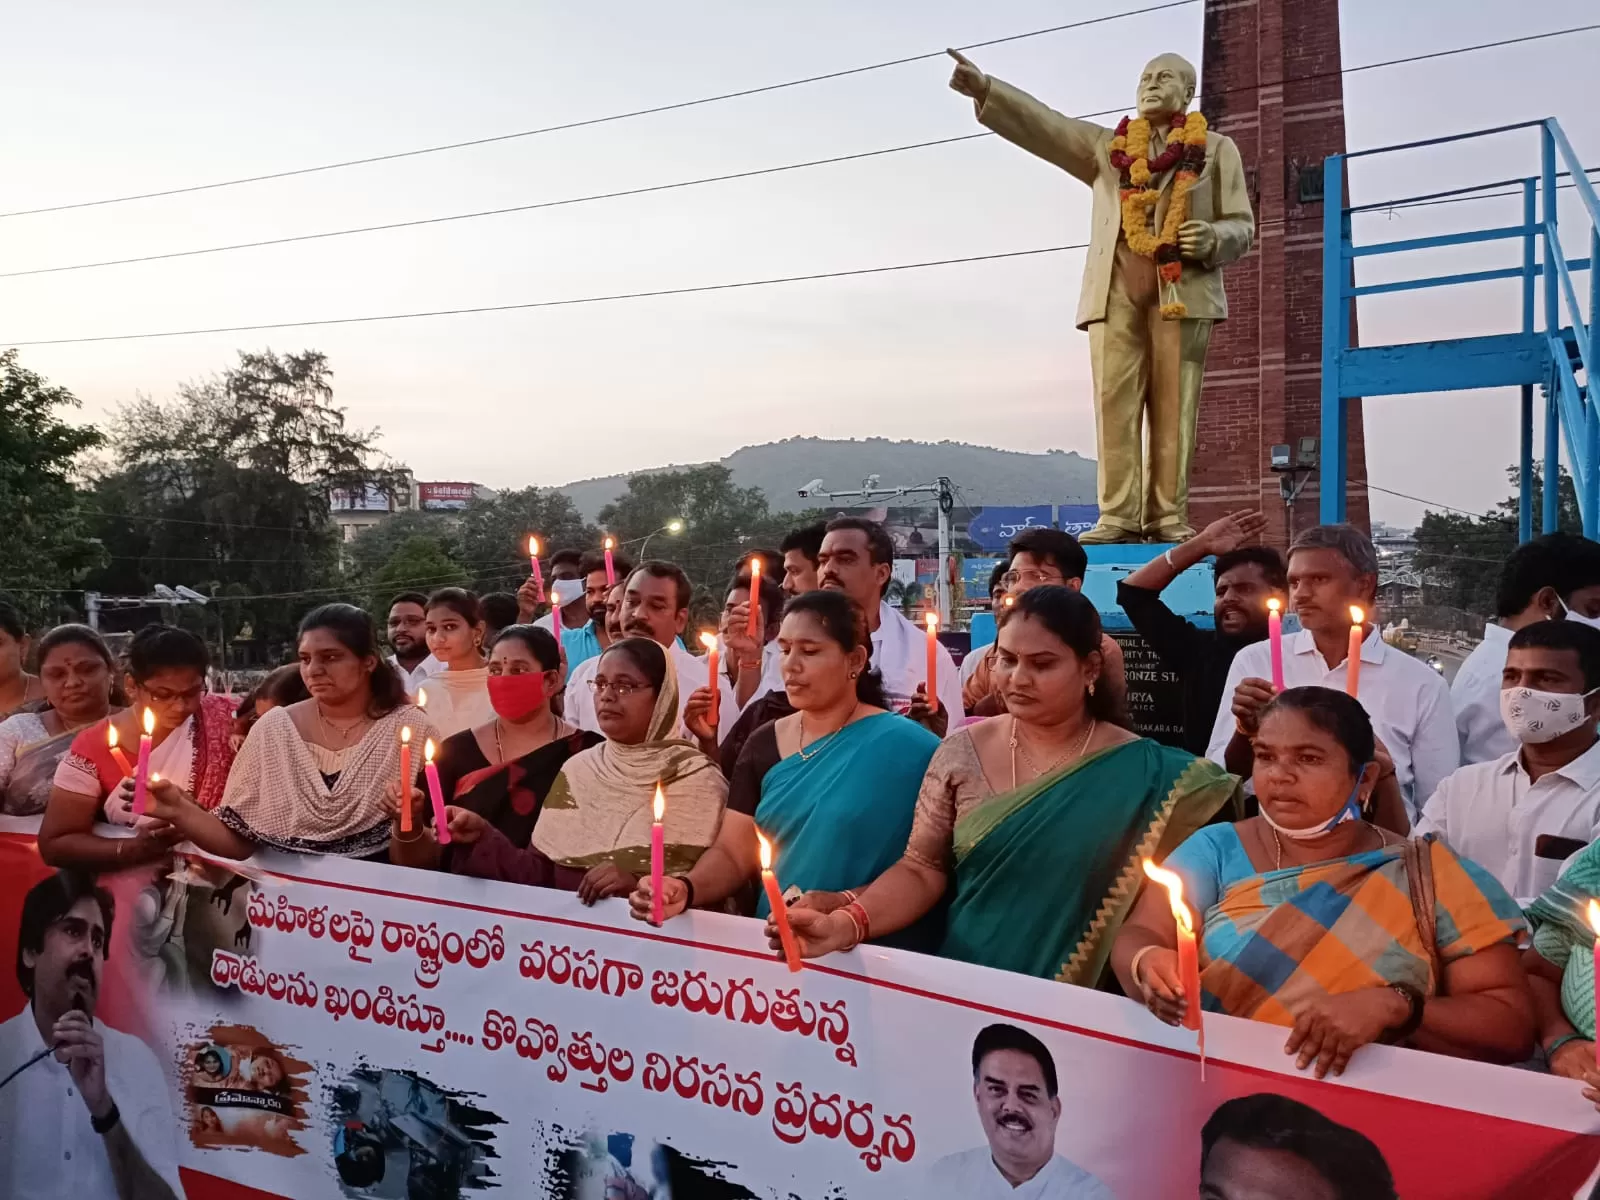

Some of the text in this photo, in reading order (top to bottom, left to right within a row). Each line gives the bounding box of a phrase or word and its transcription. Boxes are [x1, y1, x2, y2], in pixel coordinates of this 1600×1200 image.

[1116, 639, 1139, 648] ORIAL
[1123, 650, 1143, 659] RITY
[1123, 671, 1158, 682] RONZE
[247, 892, 858, 1067] మహిళలపై రాష్ట్రంలో వరసగా జరుగుతున్న
[212, 952, 318, 1008] దాడులను
[482, 1009, 634, 1093] కొవ్వొత్తుల
[642, 1052, 764, 1116] నిరసన
[772, 1081, 916, 1172] ప్రదర్శన
